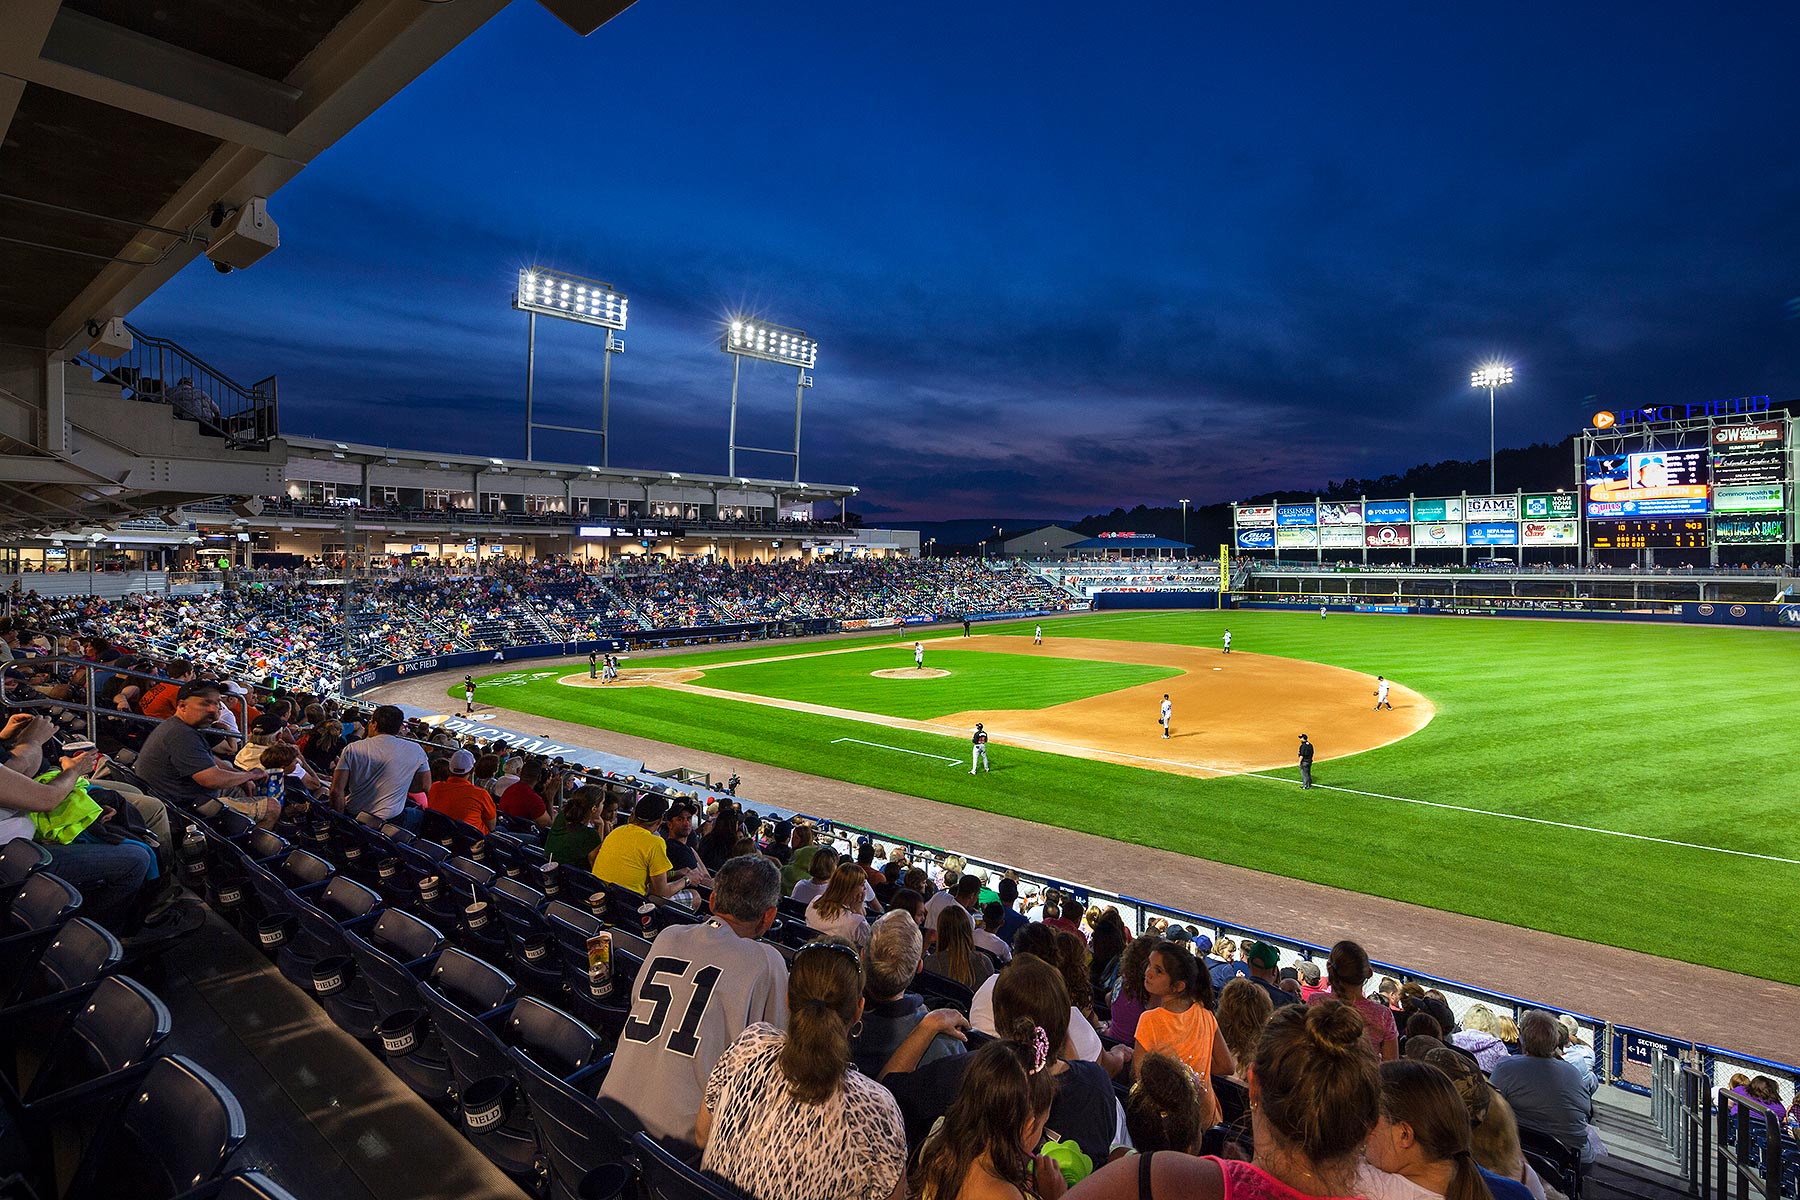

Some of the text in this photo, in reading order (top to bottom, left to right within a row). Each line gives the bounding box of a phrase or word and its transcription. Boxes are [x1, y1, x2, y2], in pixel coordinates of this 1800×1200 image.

[1620, 395, 1771, 426] PNC FIELD
[1716, 428, 1739, 442] JW
[1717, 490, 1768, 498] Commonwealth
[1277, 507, 1315, 515] GEISINGER
[1472, 500, 1514, 510] GAME
[1650, 523, 1656, 531] 2
[1761, 521, 1783, 536] BACK
[1370, 567, 1406, 575] Pennsylvania
[405, 659, 438, 673] PNC FIELD
[363, 671, 377, 685] FIELD
[315, 976, 340, 990] FIELD
[624, 955, 704, 1059] 51
[386, 1035, 413, 1049] FIELD
[1637, 1038, 1668, 1051] SECTIONS
[1635, 1046, 1647, 1057] 14
[469, 1108, 500, 1125] FIELD
